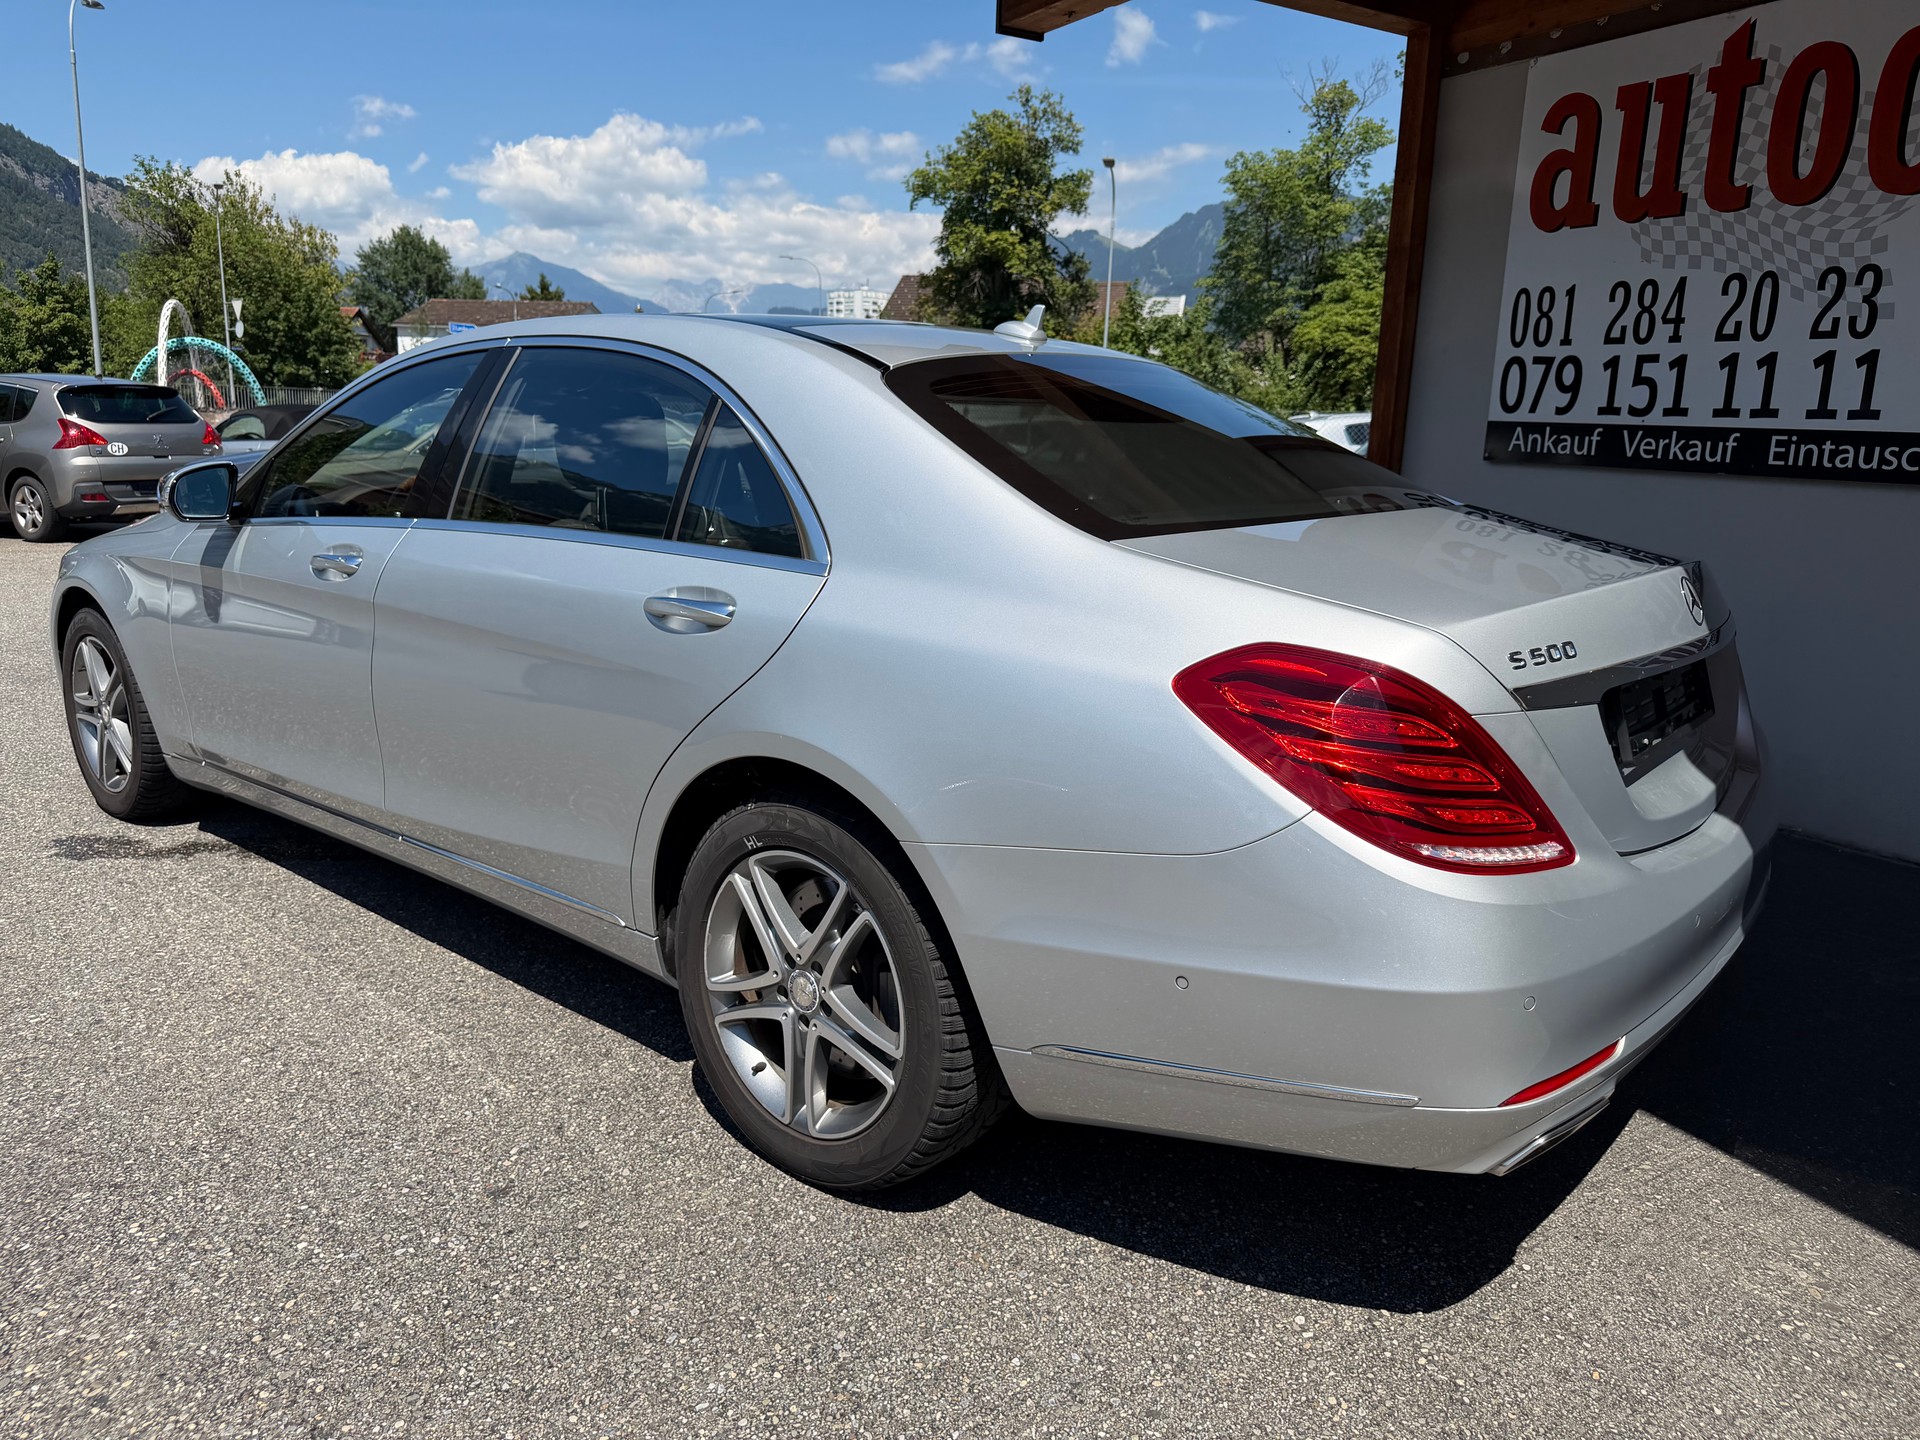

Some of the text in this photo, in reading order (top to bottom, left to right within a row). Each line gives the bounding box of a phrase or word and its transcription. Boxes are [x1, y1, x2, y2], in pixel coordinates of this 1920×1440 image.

[1509, 263, 1884, 349] 081 284 20 23
[1500, 349, 1881, 421] 079 151 11 11
[110, 442, 125, 454] CH
[1508, 426, 1602, 456] Ankauf
[1622, 430, 1740, 463] Verkauf
[1508, 641, 1577, 670] S 500
